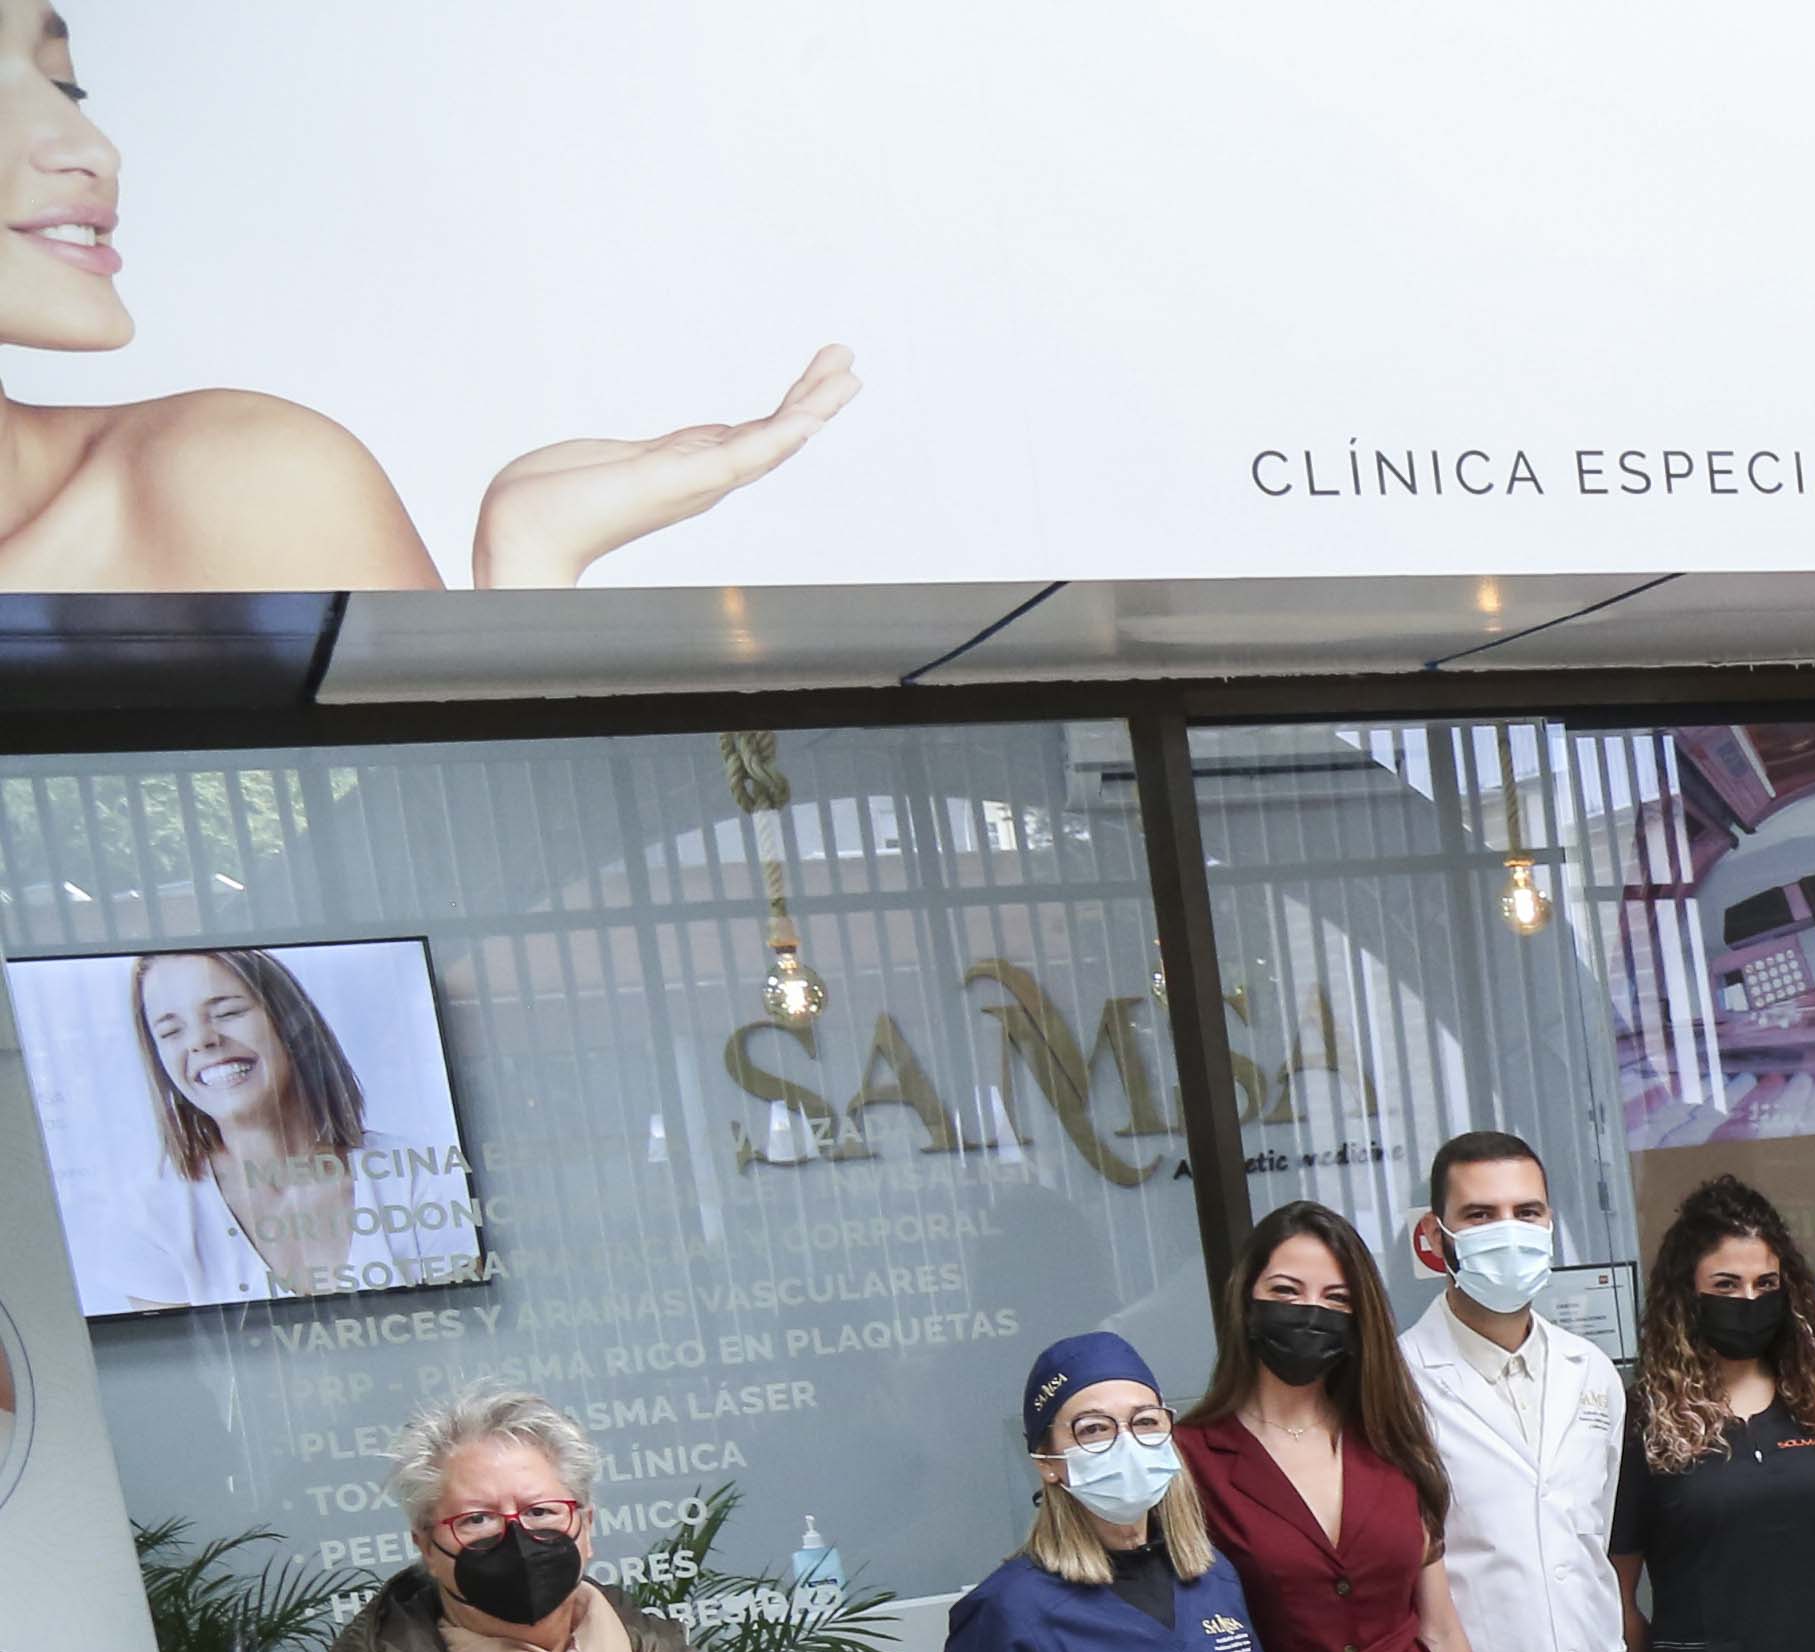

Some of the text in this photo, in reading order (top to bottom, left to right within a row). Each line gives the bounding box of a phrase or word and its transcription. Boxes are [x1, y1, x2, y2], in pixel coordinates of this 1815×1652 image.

[1251, 438, 1545, 497] CLÍNICA
[783, 1208, 1006, 1255] CORPORAL
[269, 1308, 465, 1354] VARICES
[473, 1305, 503, 1336] Y
[695, 1263, 964, 1315] VASCULARES
[604, 1339, 707, 1378] RICO
[721, 1331, 773, 1365] EN
[786, 1307, 1021, 1358] PLAQUETAS
[688, 1379, 817, 1422] LÁSER
